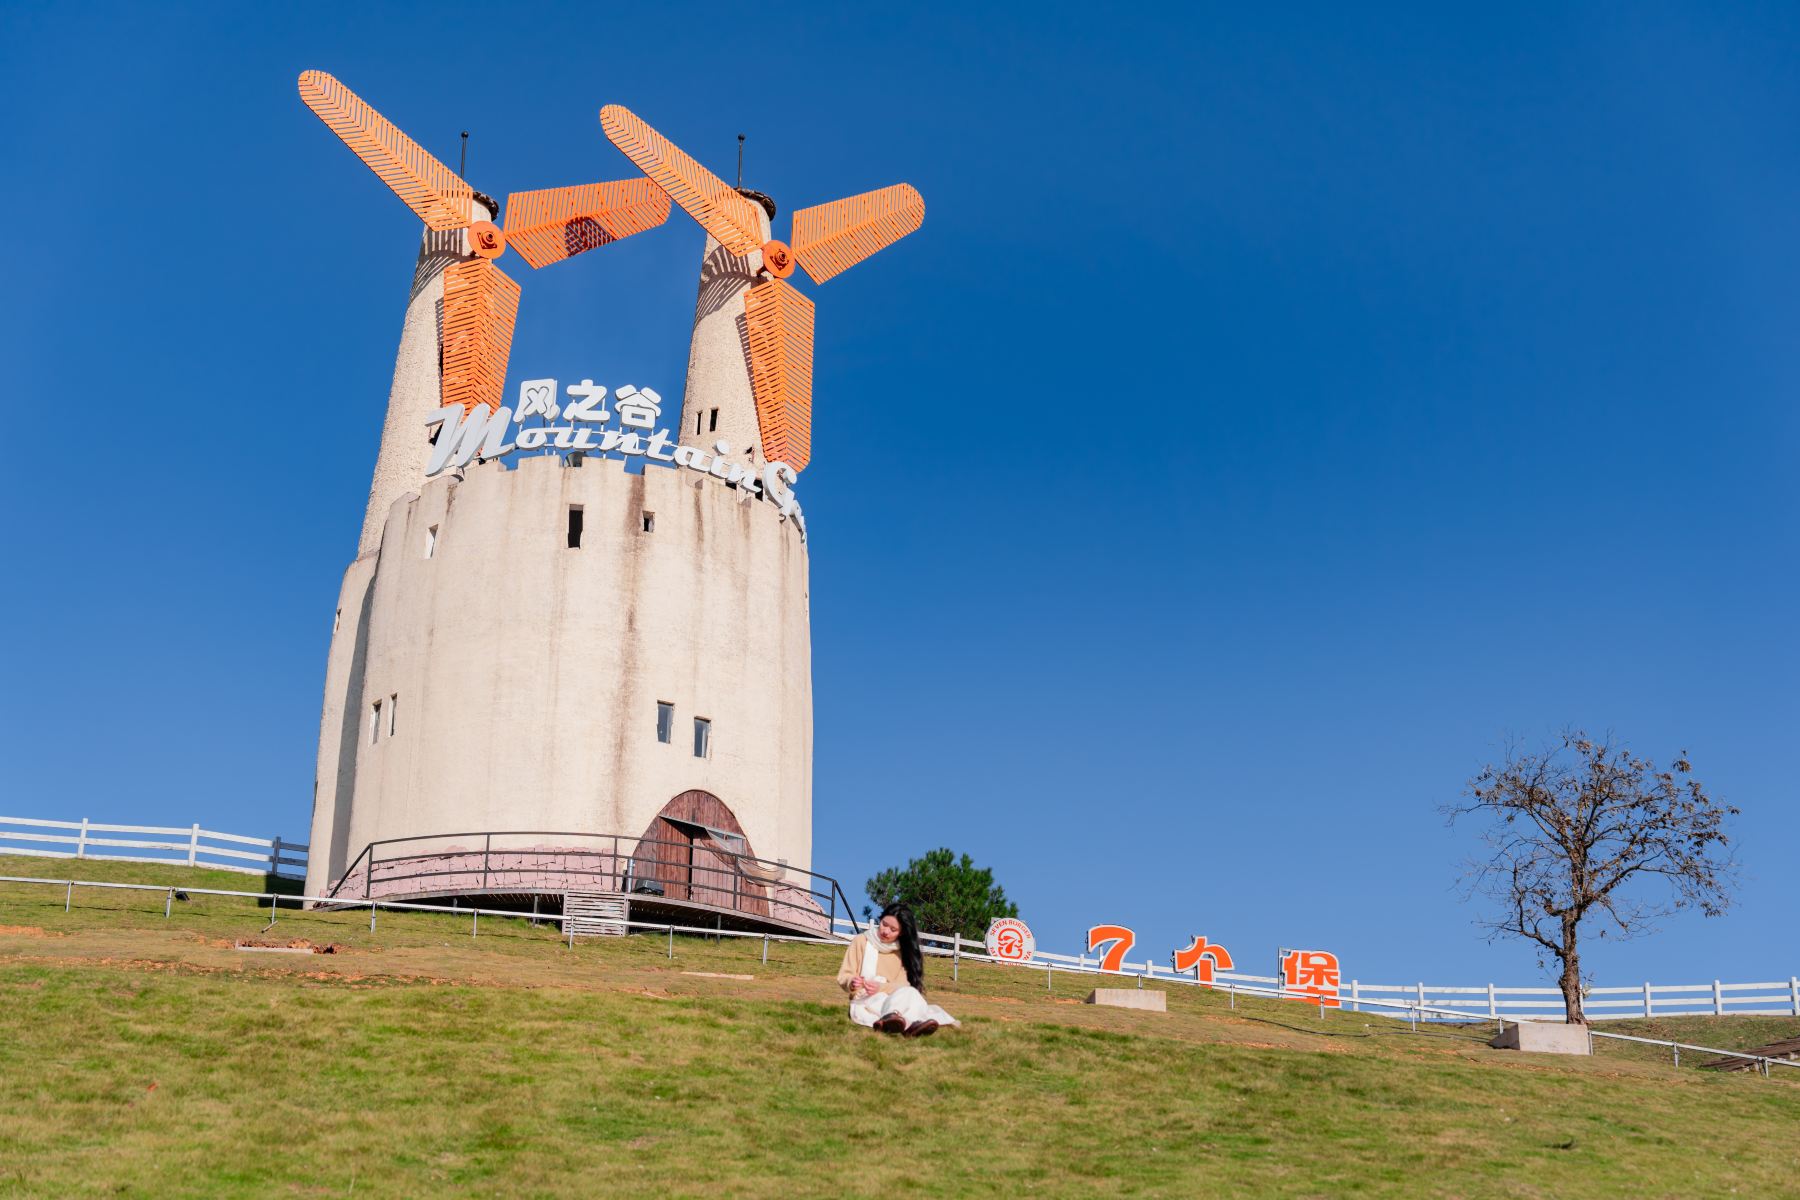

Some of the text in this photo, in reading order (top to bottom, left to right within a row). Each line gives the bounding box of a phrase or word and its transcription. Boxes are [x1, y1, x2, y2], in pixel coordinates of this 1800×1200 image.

[513, 378, 662, 430] 风之谷
[990, 919, 1031, 939] SEVEN BURGER
